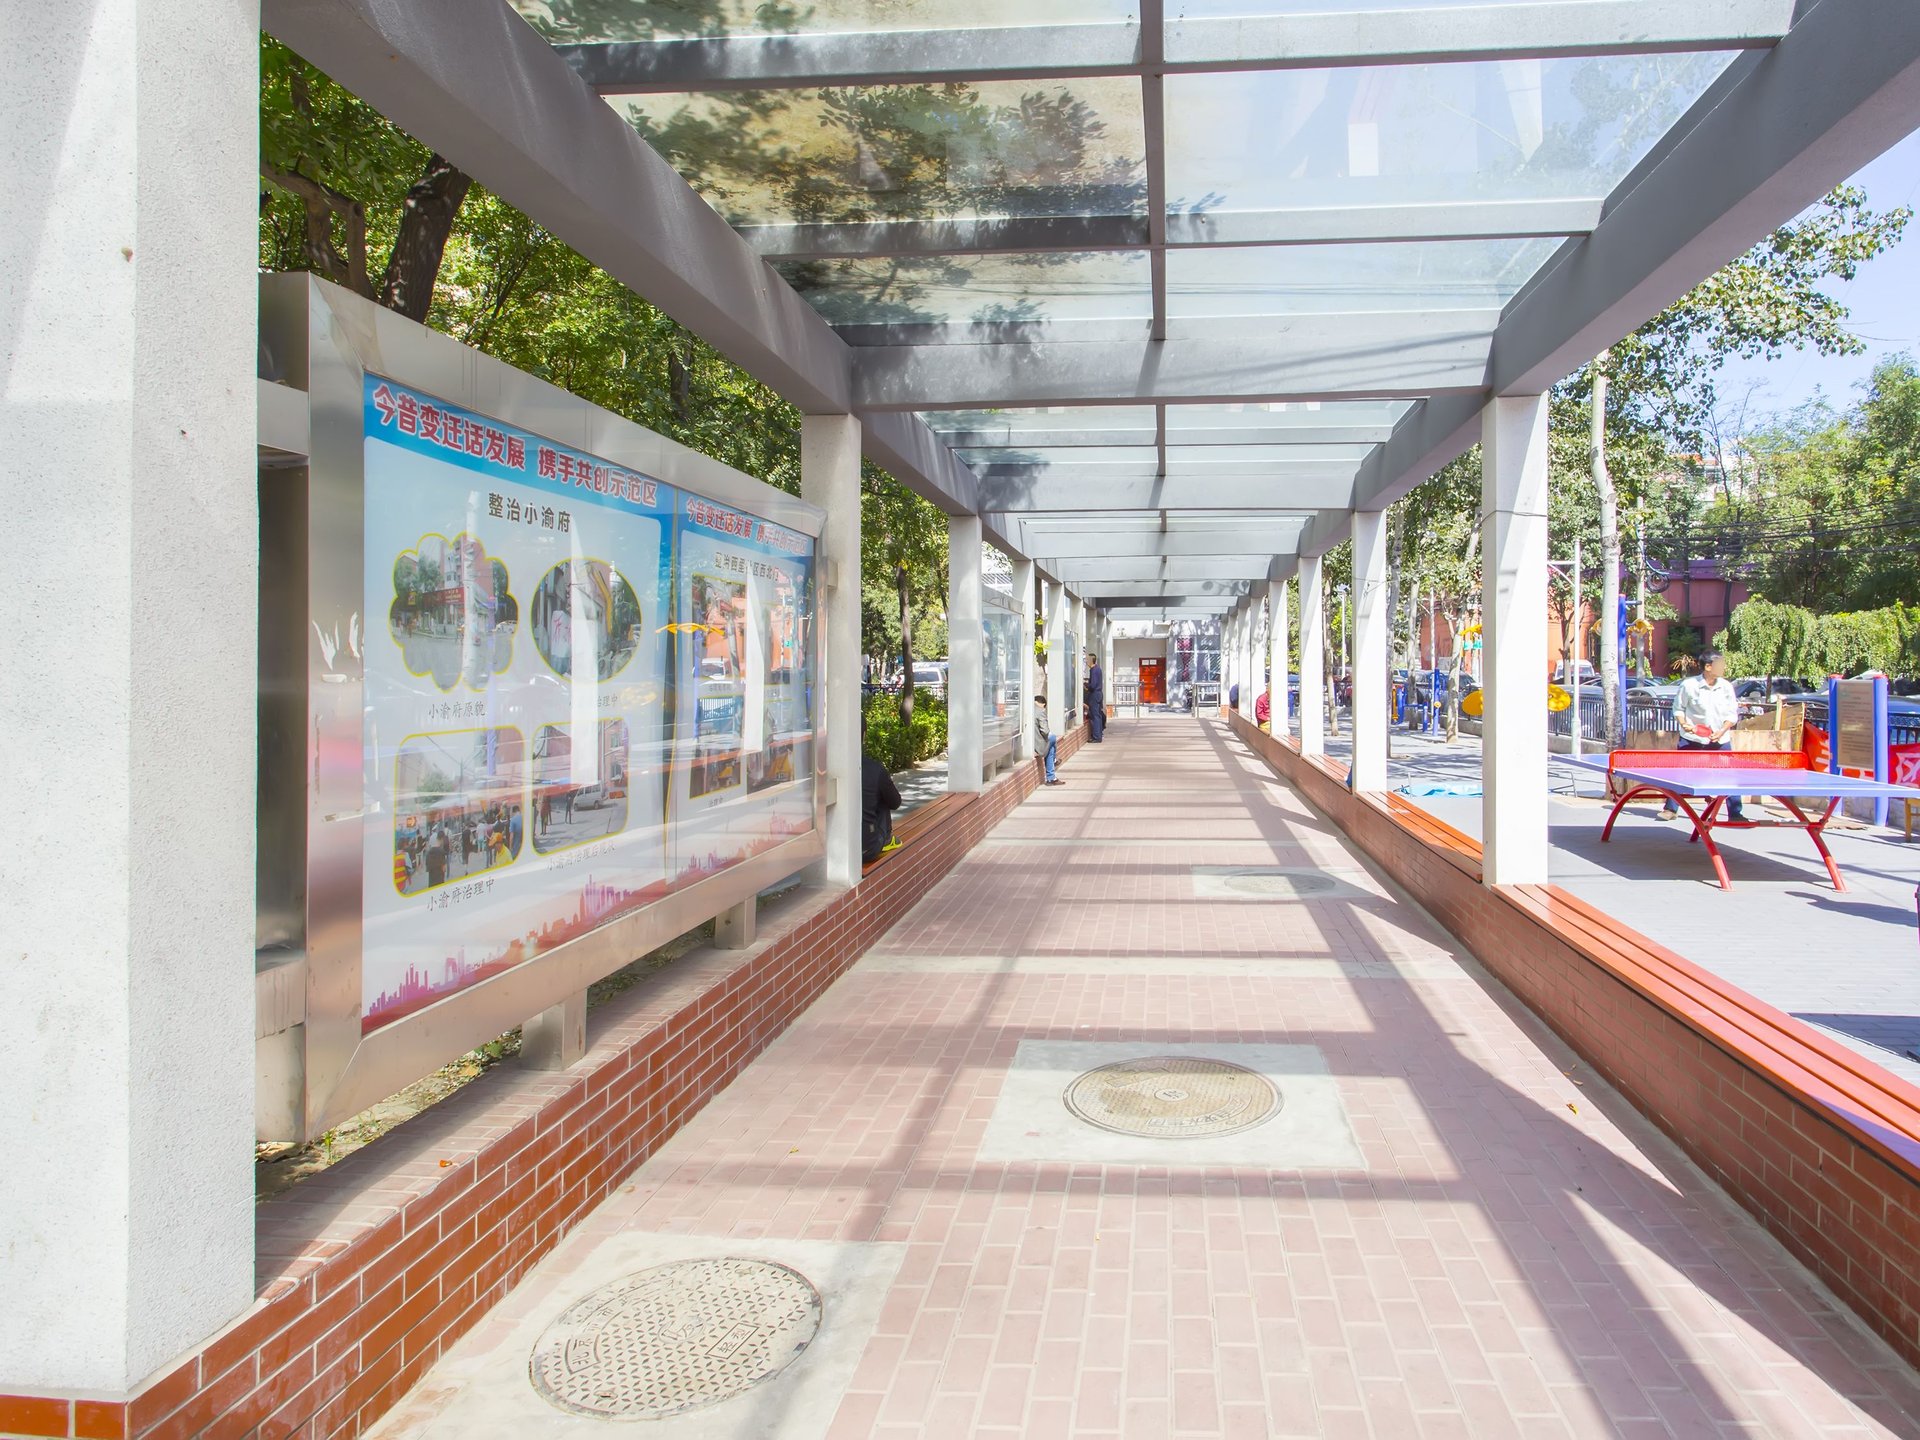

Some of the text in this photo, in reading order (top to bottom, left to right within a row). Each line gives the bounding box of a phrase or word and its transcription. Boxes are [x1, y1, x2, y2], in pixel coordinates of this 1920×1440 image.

[374, 384, 658, 507] 今昔变迁话发展 携手共创示范区
[488, 492, 571, 533] 整治小渝府
[687, 498, 753, 538] 今昔变迁话发展
[427, 877, 495, 912] 小渝府治理中
